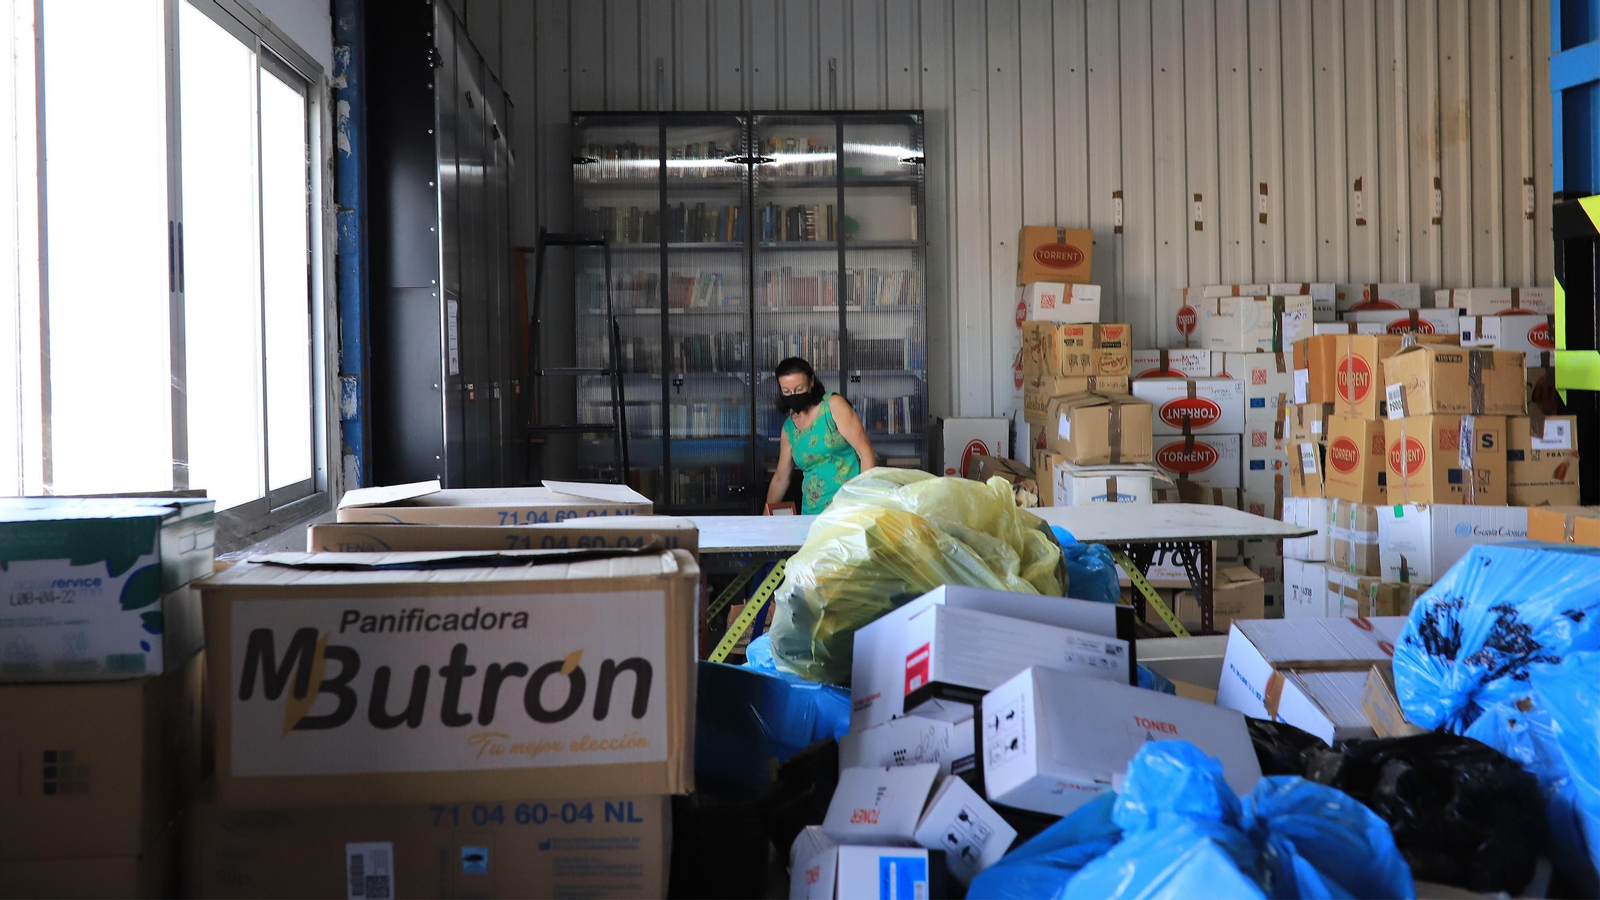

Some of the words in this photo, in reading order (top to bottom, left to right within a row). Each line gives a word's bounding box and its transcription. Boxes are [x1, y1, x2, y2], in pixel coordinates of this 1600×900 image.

[1040, 250, 1078, 261] TORRENT
[1390, 325, 1429, 335] TORNT
[1532, 331, 1549, 340] TOR
[1338, 370, 1368, 387] TORENT
[1166, 407, 1214, 419] TORRENT
[1481, 433, 1494, 448] S
[1163, 451, 1210, 462] TORRENT
[1332, 447, 1356, 463] TORRENT
[1391, 448, 1420, 464] TOENT
[498, 511, 518, 526] 71
[526, 510, 549, 525] 04
[505, 535, 531, 549] 71
[541, 535, 569, 550] 04
[577, 535, 643, 550] 60-04
[339, 607, 529, 634] Panificadora
[1133, 715, 1178, 735] TONER
[467, 732, 509, 761] Tu
[509, 739, 564, 759] mejor
[569, 733, 650, 753] elección
[433, 805, 460, 826] 71
[471, 804, 505, 826] 04
[514, 802, 594, 825] 60-04
[604, 801, 644, 823] NL
[850, 808, 881, 825] TONER
